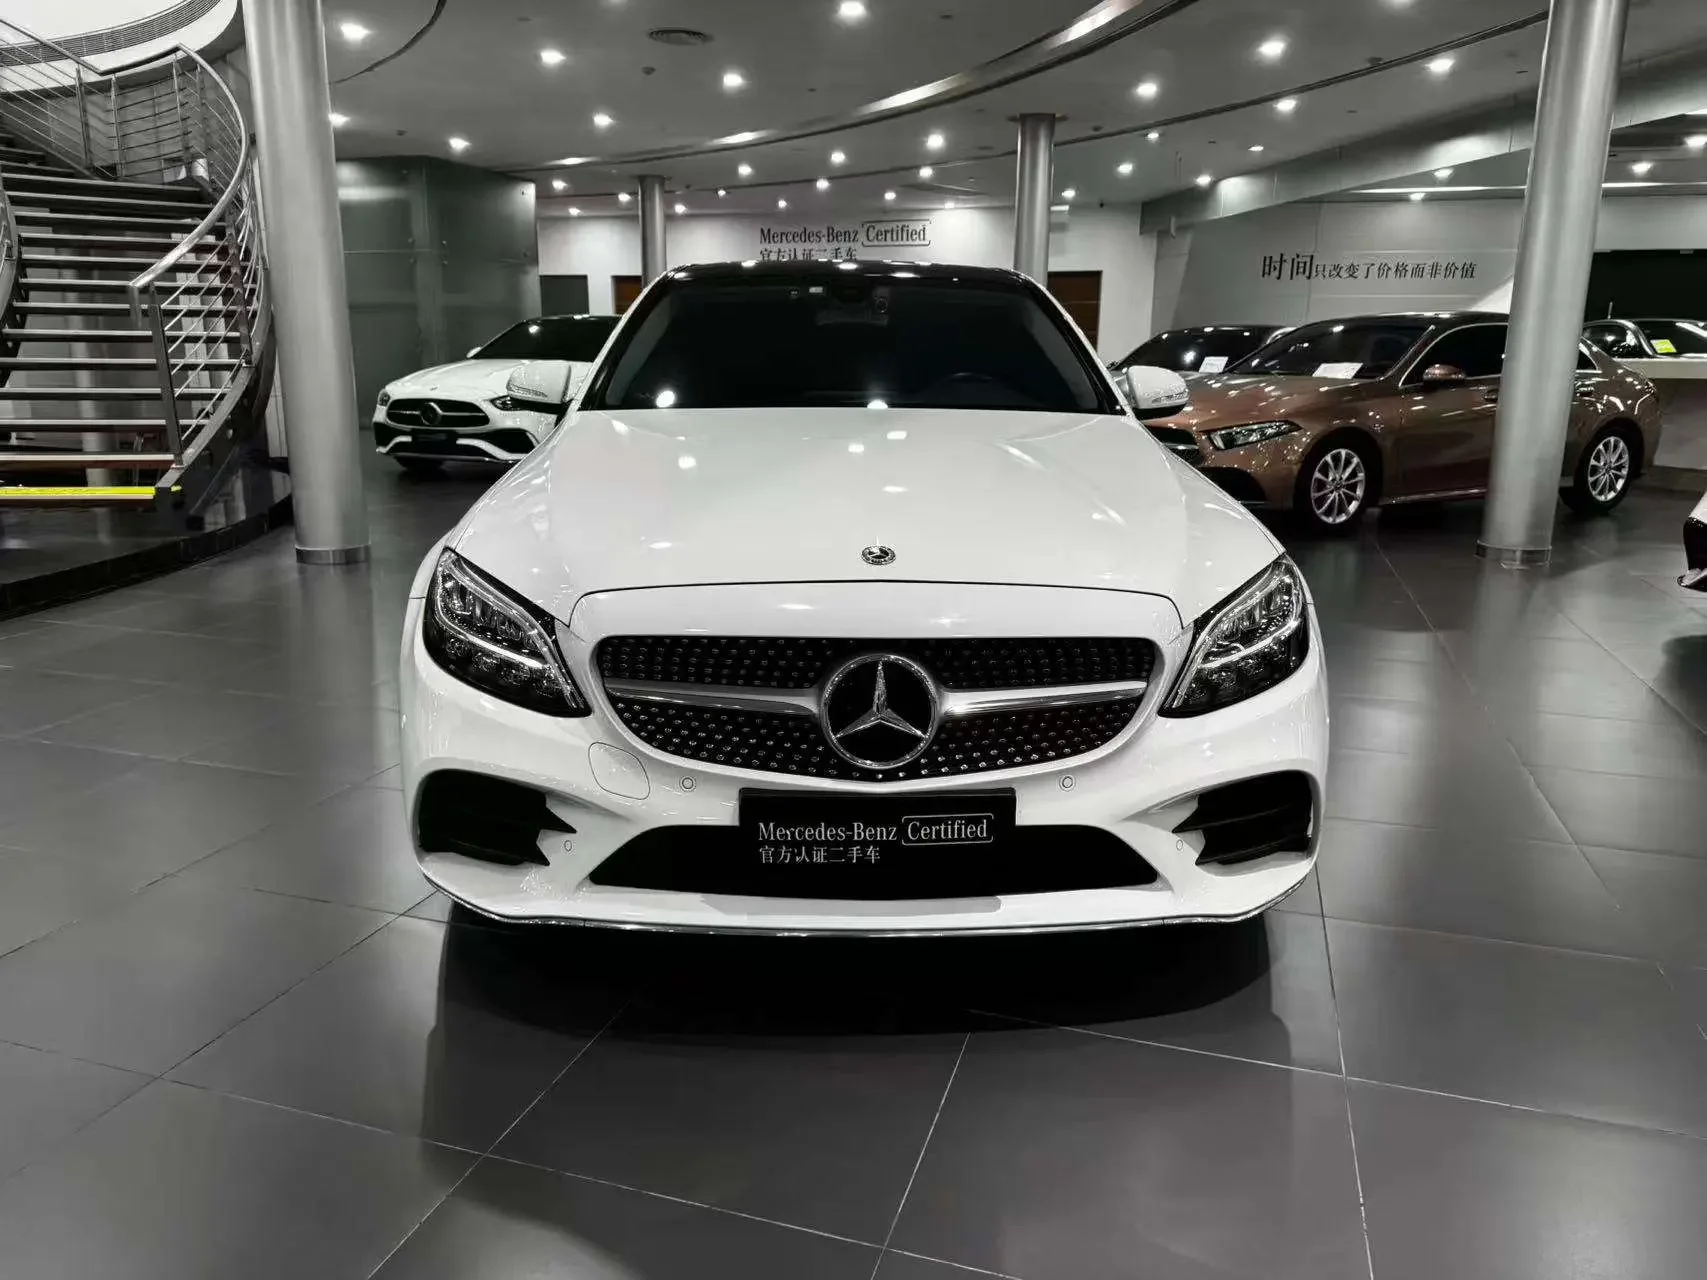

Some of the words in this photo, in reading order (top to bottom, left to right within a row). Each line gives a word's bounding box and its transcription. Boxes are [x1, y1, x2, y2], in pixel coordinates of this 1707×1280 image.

[760, 227, 859, 244] Mercedes-Benz
[866, 224, 926, 242] Certified
[758, 822, 897, 841] Mercedes-Benz
[907, 819, 988, 840] Certified
[759, 846, 881, 864] 官方认证二手车
